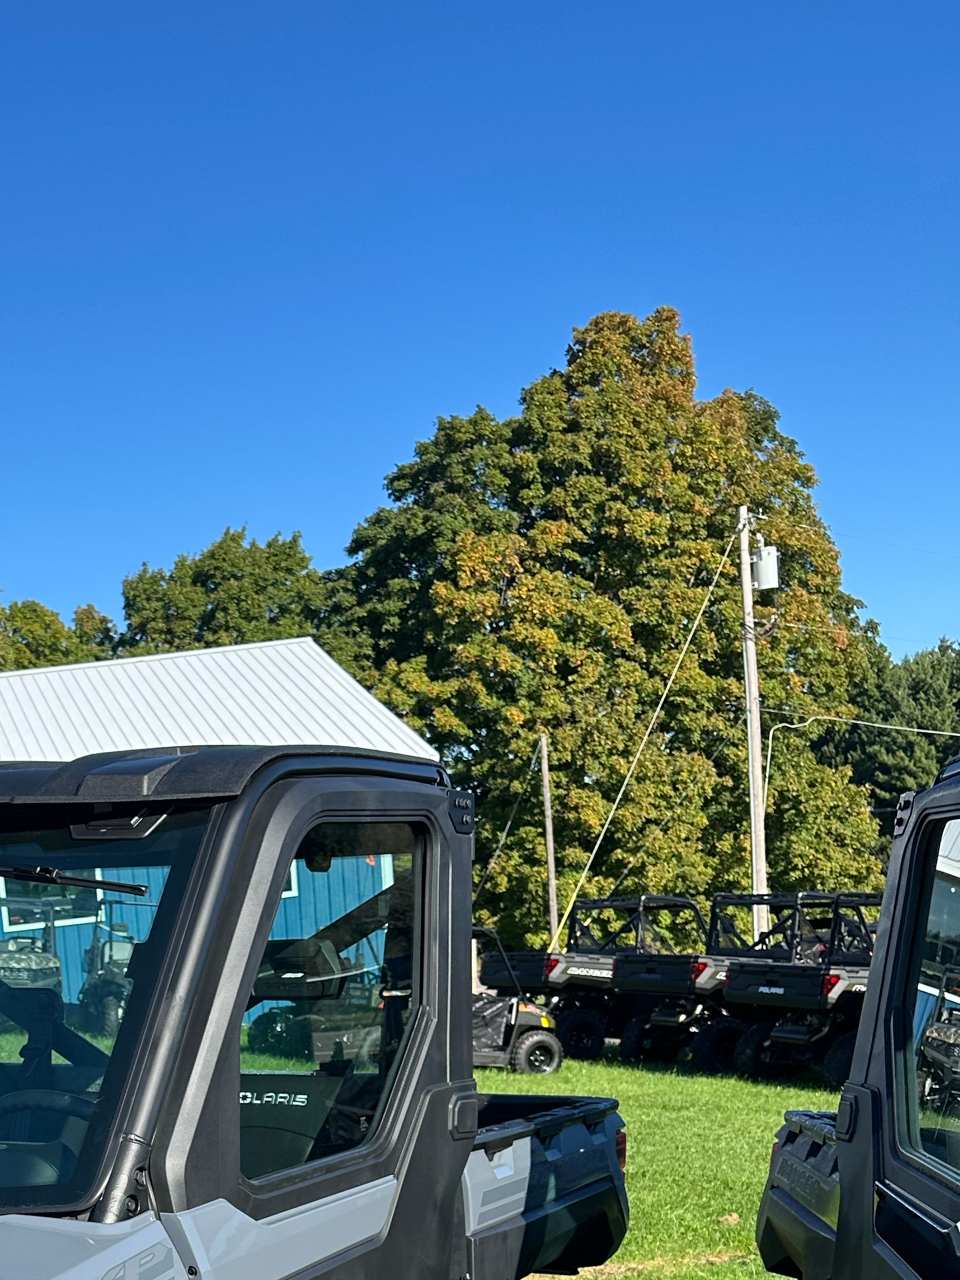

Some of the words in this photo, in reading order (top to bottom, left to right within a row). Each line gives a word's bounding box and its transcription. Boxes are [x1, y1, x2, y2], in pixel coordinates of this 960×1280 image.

[567, 966, 613, 979] RANGER
[758, 986, 784, 995] POLARIS
[239, 1092, 308, 1106] OLARIS
